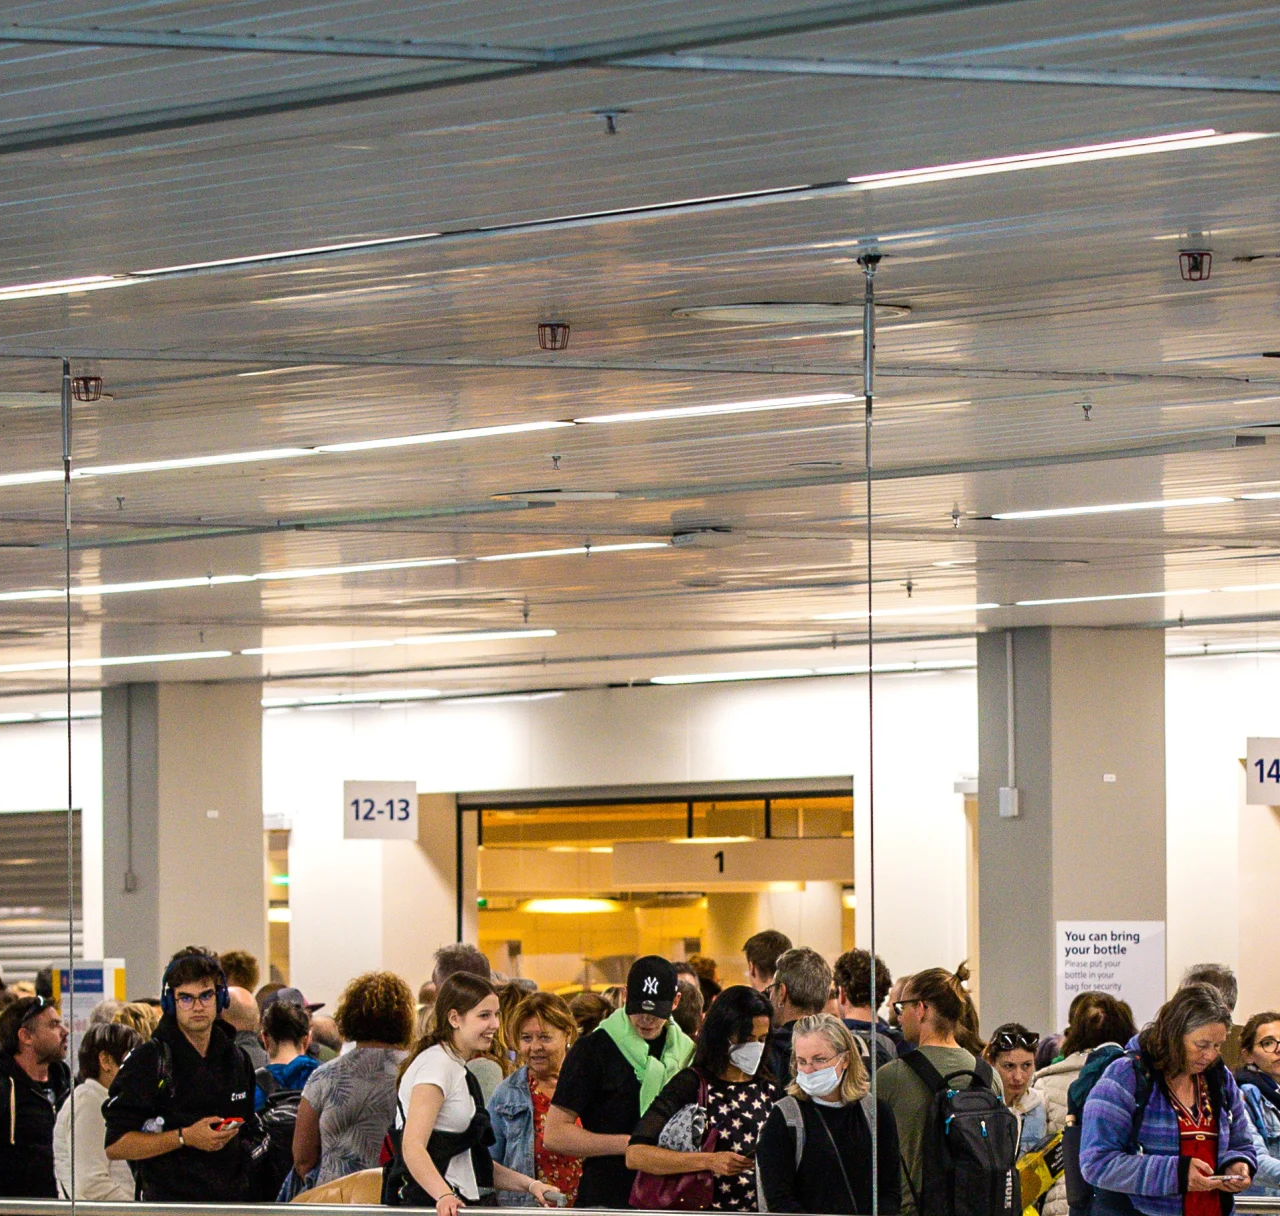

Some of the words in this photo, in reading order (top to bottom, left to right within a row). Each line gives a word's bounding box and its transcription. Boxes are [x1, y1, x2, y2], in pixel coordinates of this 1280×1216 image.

[351, 798, 410, 821] 12-13
[714, 850, 724, 873] 1
[1065, 931, 1086, 942] You
[1089, 932, 1107, 942] can
[1111, 930, 1140, 944] bring
[1065, 946, 1090, 957] your
[1093, 944, 1127, 955] bottle
[1065, 959, 1088, 968] Please
[1089, 960, 1102, 970] put
[1104, 960, 1121, 970] your
[1065, 970, 1087, 979] bottle
[1088, 970, 1096, 979] in
[1097, 971, 1115, 981] your
[642, 976, 659, 995] NY
[1065, 982, 1080, 992] bag
[1081, 982, 1091, 991] for
[1093, 982, 1122, 992] security
[1003, 1168, 1013, 1209] THULE
